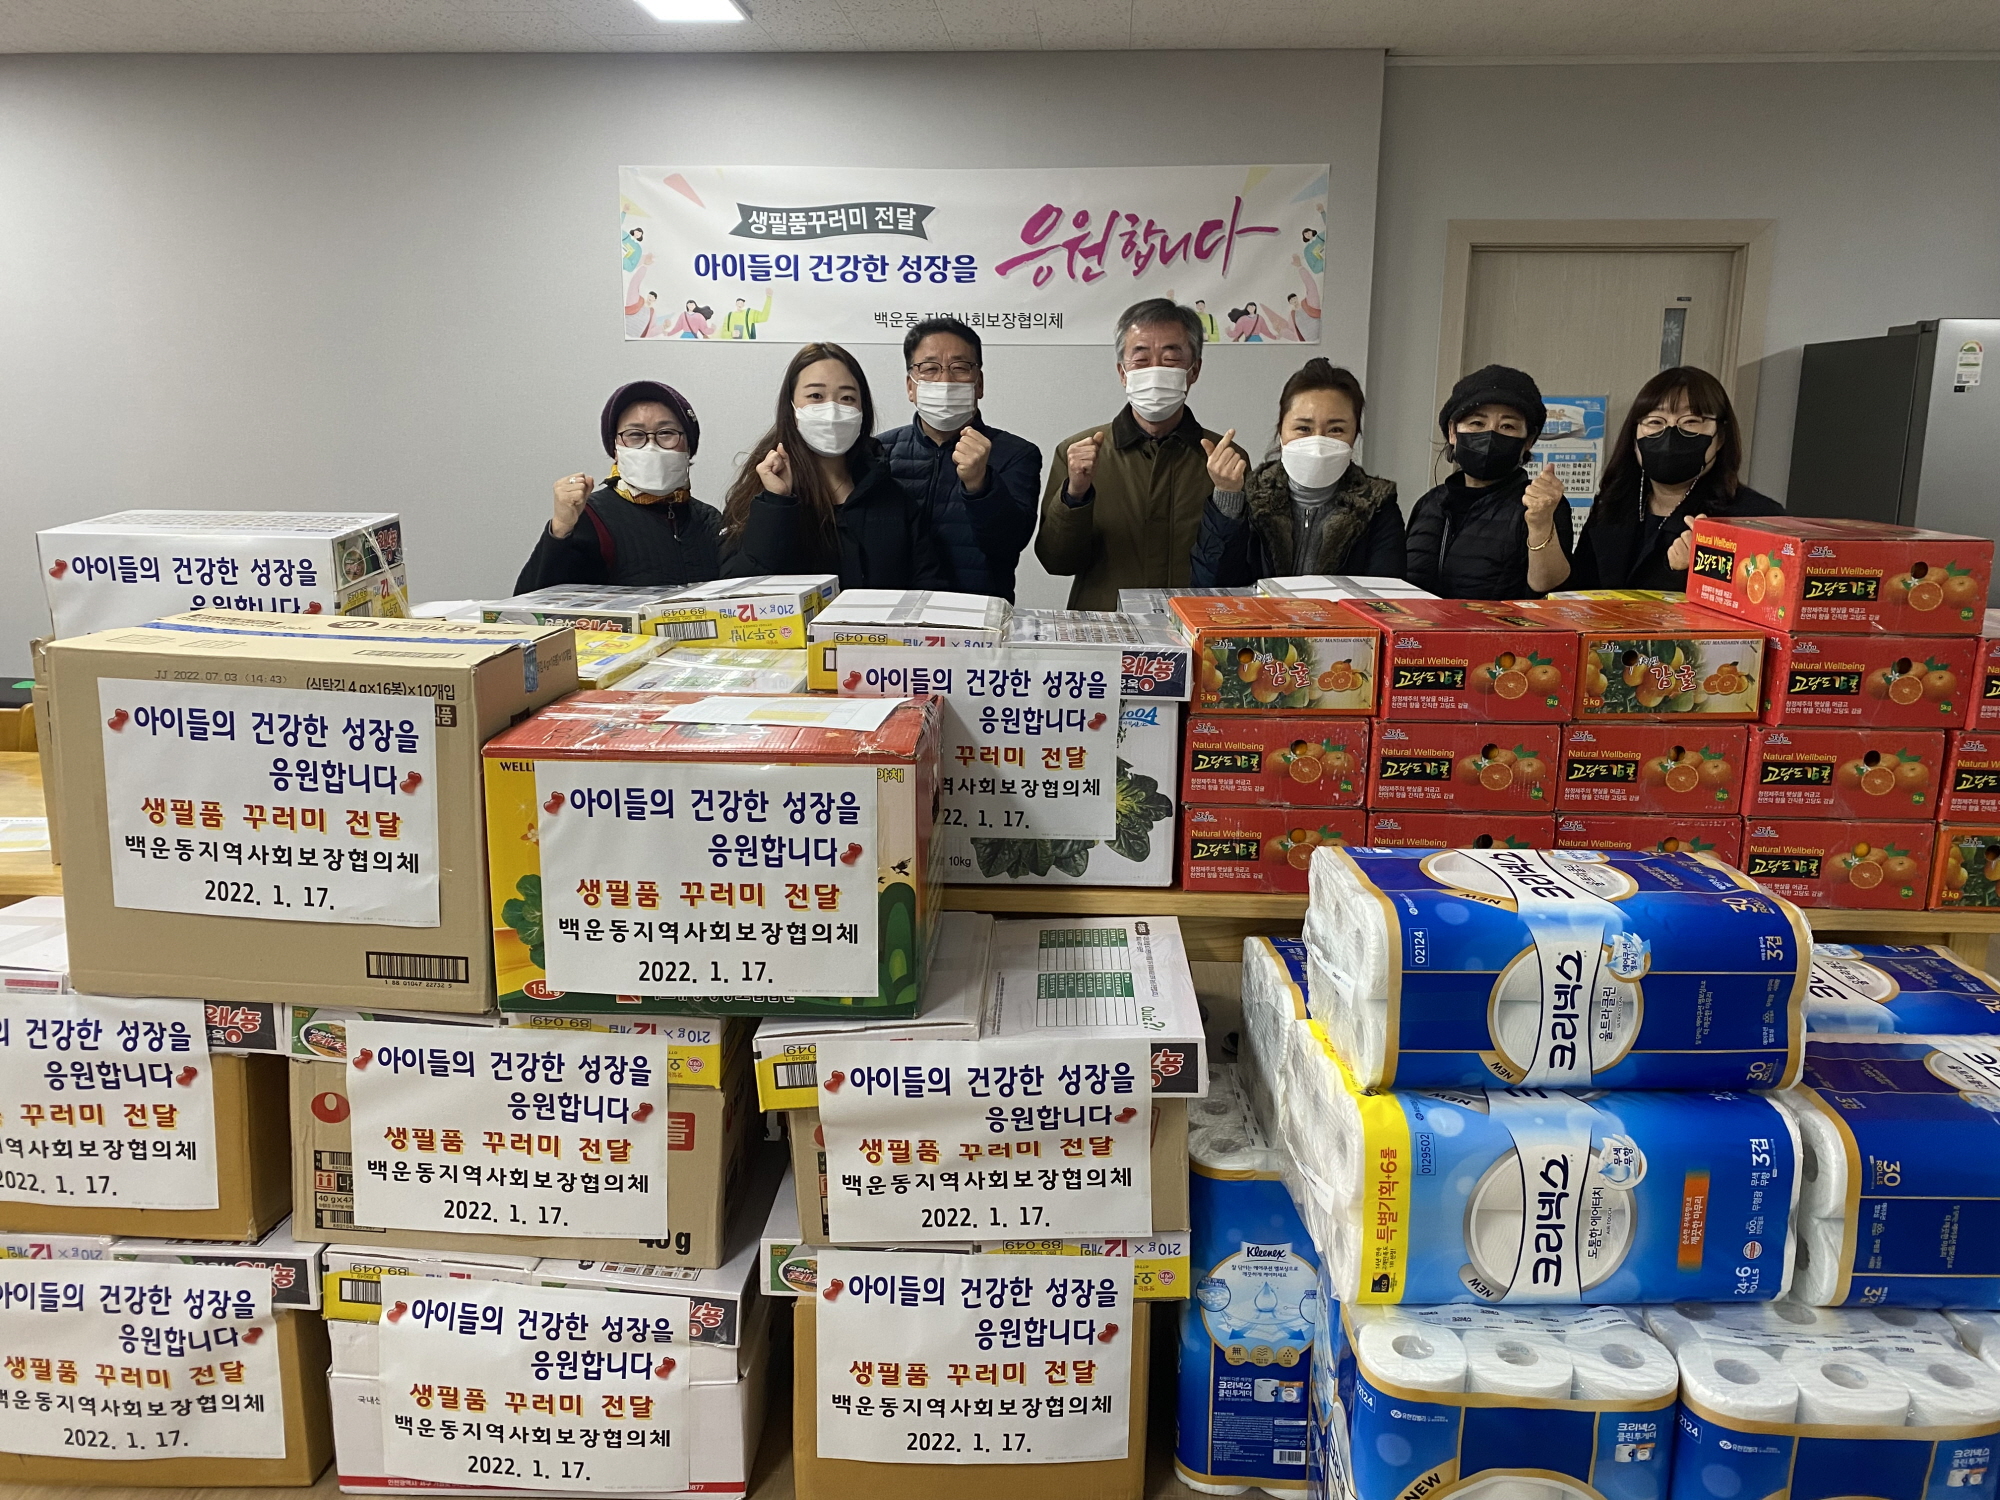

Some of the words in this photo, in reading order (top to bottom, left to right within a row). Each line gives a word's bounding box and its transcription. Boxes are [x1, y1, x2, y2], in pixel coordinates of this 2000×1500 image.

[747, 206, 869, 233] 생필품꾸러미
[874, 205, 918, 231] 전달
[994, 195, 1281, 289] 응원합니다
[693, 252, 801, 282] 아이들의
[809, 252, 890, 282] 건강한
[897, 252, 978, 284] 성장을
[873, 310, 920, 329] 백운동
[71, 555, 160, 584] 아이들의
[171, 556, 239, 587] 건강한
[250, 558, 318, 588] 성장을
[1807, 567, 1838, 575] Natural
[1841, 567, 1883, 576] Wellbeing
[728, 628, 777, 642] 오뚜기밥
[154, 670, 168, 680] JJ
[174, 671, 238, 684] 2022.07.03
[245, 674, 288, 684] (14:43)
[1264, 661, 1312, 688] 감귤
[1394, 657, 1424, 665] Natural
[1427, 657, 1469, 667] Wellbeing
[865, 667, 952, 695] 아이들의
[966, 667, 1032, 698] 건강한
[1041, 670, 1108, 700] 성장을
[1650, 665, 1698, 692] 감귤
[133, 705, 236, 742] 아이들의
[251, 712, 329, 748] 건강한
[341, 716, 420, 754] 성장을
[978, 705, 1087, 736] 응원합니다
[954, 745, 1025, 769] 꾸러미
[1040, 745, 1088, 771] 전달
[268, 757, 398, 796] 응원합니다
[877, 769, 904, 783] 야채
[140, 796, 225, 829] 생필품
[242, 804, 326, 834] 꾸러미
[345, 809, 402, 839] 전달
[569, 787, 674, 821] 아이들의
[690, 788, 770, 824] 건강한
[782, 790, 861, 826] 성장을
[124, 835, 419, 874] 백운동지역사회보장협의체
[707, 833, 838, 869] 응원합니다
[949, 857, 971, 868] 10kg
[204, 879, 261, 906] 2022.
[273, 884, 291, 908] 1.
[303, 886, 335, 911] 17.
[575, 878, 661, 909] 생필품
[679, 881, 764, 908] 꾸러미
[784, 883, 841, 911] 전달
[558, 918, 859, 946] 백운동지역사회보장협의체
[1413, 930, 1426, 965] 02124
[1767, 936, 1783, 961] 3겹
[638, 960, 698, 984] 2022.
[710, 960, 729, 984] 1.
[741, 960, 773, 984] 17.
[1549, 950, 1584, 1072] 크리넥스
[1599, 986, 1616, 1042] 울트라클린
[25, 1017, 103, 1052] 건강한
[116, 1019, 192, 1053] 성장을
[43, 1060, 174, 1092] 응원합니다
[377, 1046, 475, 1078] 아이들의
[490, 1050, 566, 1083] 건강한
[577, 1054, 652, 1087] 성장을
[849, 1065, 951, 1099] 아이들의
[967, 1063, 1045, 1098] 건강한
[1057, 1061, 1135, 1096] 성장을
[1491, 1061, 1515, 1080] NEW
[1747, 1061, 1766, 1081] 30
[1761, 1062, 1774, 1081] ROLLS
[507, 1091, 630, 1125] 응원합니다
[984, 1104, 1113, 1134] 응원합니다
[383, 1126, 465, 1154] 생필품
[482, 1131, 560, 1159] 꾸러미
[578, 1137, 633, 1164] 전달
[858, 1138, 941, 1165] 생필품
[958, 1140, 1041, 1163] 꾸러미
[1059, 1135, 1115, 1158] 전달
[1419, 1134, 1432, 1174] 0129502
[1613, 1147, 1623, 1166] 무색
[1622, 1147, 1633, 1166] 무향
[1752, 1139, 1770, 1167] 3겹
[367, 1159, 649, 1194] 백운동지역사회보장협의체
[841, 1166, 1132, 1197] 백운동지역사회보장협의체
[1876, 1160, 1884, 1185] ROLLS
[1883, 1161, 1901, 1186] 30
[1376, 1147, 1398, 1244] 특별기획+6롤
[1589, 1187, 1604, 1227] 에어터치
[1692, 1196, 1705, 1219] 마무리
[443, 1199, 498, 1224] 2022.
[509, 1204, 527, 1225] 1.
[538, 1205, 569, 1227] 17.
[921, 1207, 978, 1229] 2022.
[989, 1206, 1008, 1228] 1.
[1019, 1206, 1050, 1228] 17.
[1532, 1153, 1569, 1288] 크리넥스
[1588, 1228, 1602, 1259] 도톰한
[1690, 1220, 1703, 1245] 깨끗한
[1246, 1246, 1286, 1260] Kleenex
[99, 1283, 173, 1316] 건강한
[183, 1287, 256, 1320] 성장을
[848, 1274, 945, 1307] 아이들의
[960, 1275, 1034, 1309] 건강한
[1045, 1277, 1119, 1309] 성장을
[1469, 1278, 1492, 1298] NEW
[411, 1298, 504, 1336] 아이들의
[517, 1308, 589, 1342] 건강한
[600, 1315, 674, 1344] 성장을
[974, 1316, 1096, 1351] 응원합니다
[118, 1323, 239, 1358] 응원합니다
[3, 1355, 79, 1385] 생필품
[94, 1363, 171, 1390] 꾸러미
[188, 1360, 246, 1387] 전달
[530, 1349, 653, 1381] 응원합니다
[848, 1360, 930, 1388] 생필품
[946, 1361, 1026, 1387] 꾸러미
[1044, 1359, 1098, 1386] 전달
[1218, 1381, 1252, 1389] 크리넥스
[409, 1383, 488, 1413] 생필품
[504, 1391, 583, 1417] 꾸러미
[601, 1394, 655, 1420] 전달
[831, 1393, 1112, 1419] 백운동지역사회보장협의체
[63, 1427, 116, 1450] 2022.
[126, 1432, 146, 1450] 1.
[155, 1429, 189, 1448] 17.
[394, 1413, 671, 1449] 백운동지역사회보장협의체
[1617, 1422, 1657, 1432] 크리넥스
[1617, 1432, 1657, 1442] 클린투게더
[906, 1432, 961, 1453] 2022.
[973, 1432, 990, 1453] 1.
[1002, 1432, 1032, 1453] 17.
[467, 1455, 522, 1478] 2022.
[532, 1459, 550, 1480] 1.
[561, 1461, 591, 1481] 17.
[1404, 1473, 1441, 1500] NEW
